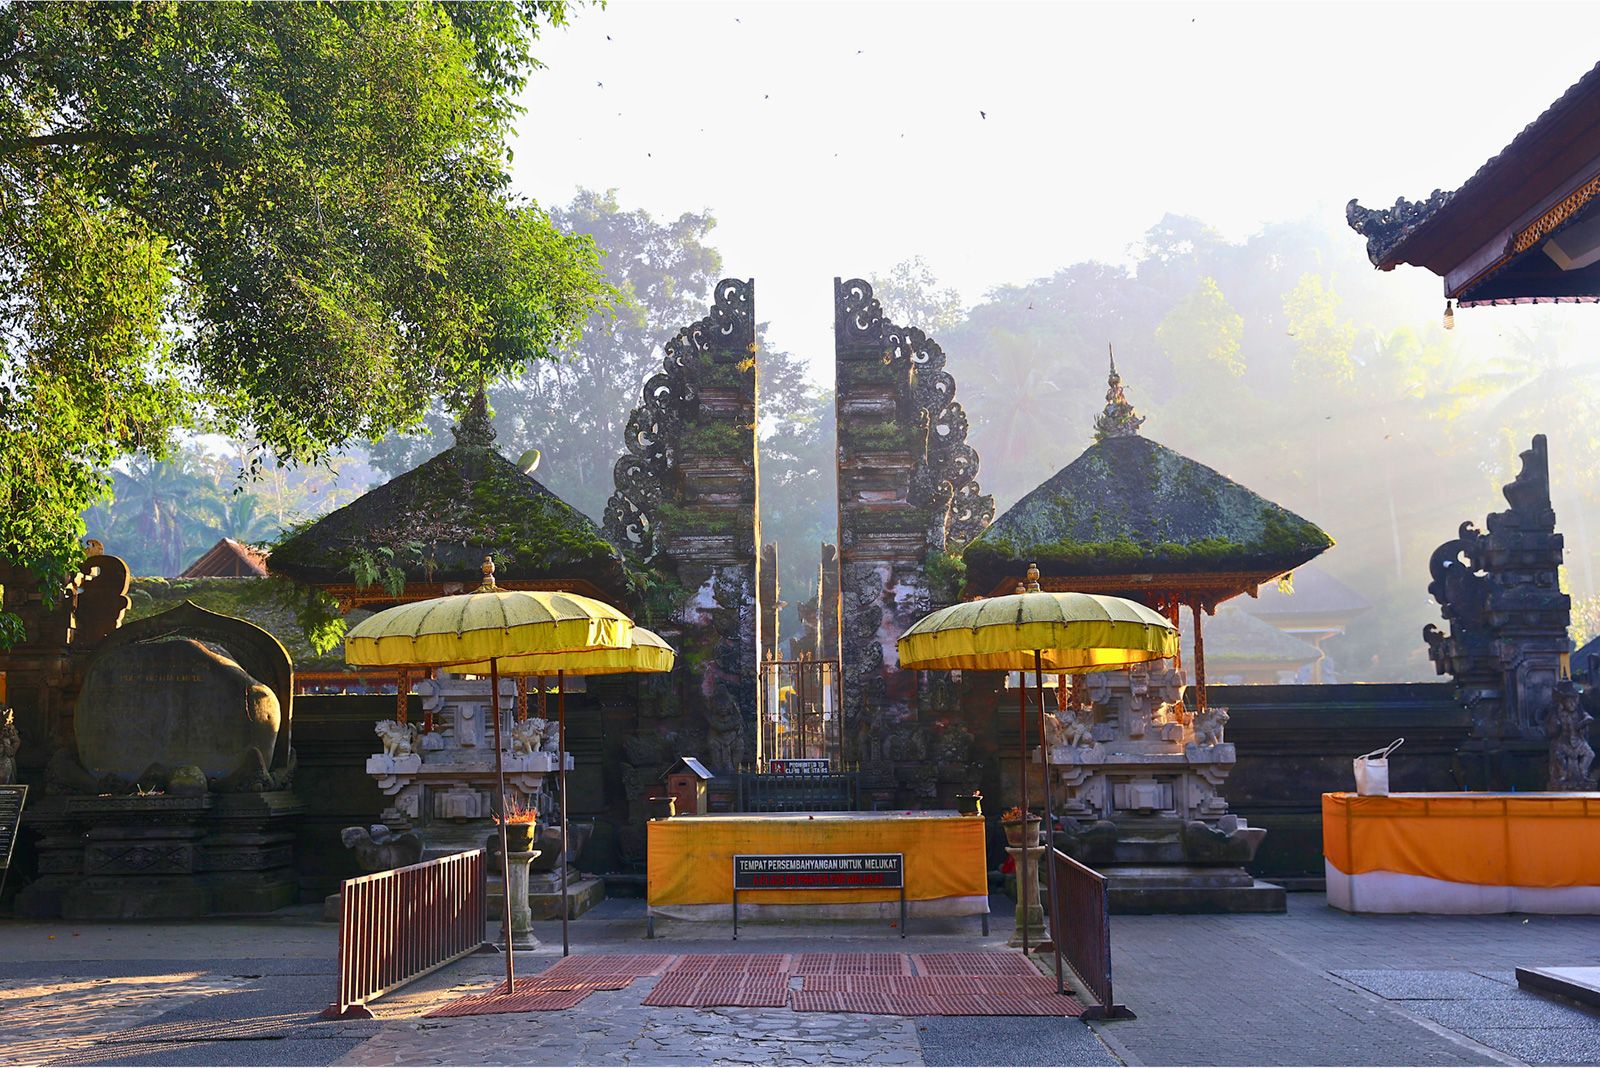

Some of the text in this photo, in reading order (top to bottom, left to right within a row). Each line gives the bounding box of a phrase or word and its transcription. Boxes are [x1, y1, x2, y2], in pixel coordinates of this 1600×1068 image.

[739, 859, 898, 870] TEMPAT PERSEMBAHYANGAN UNTUK MELUKAT
